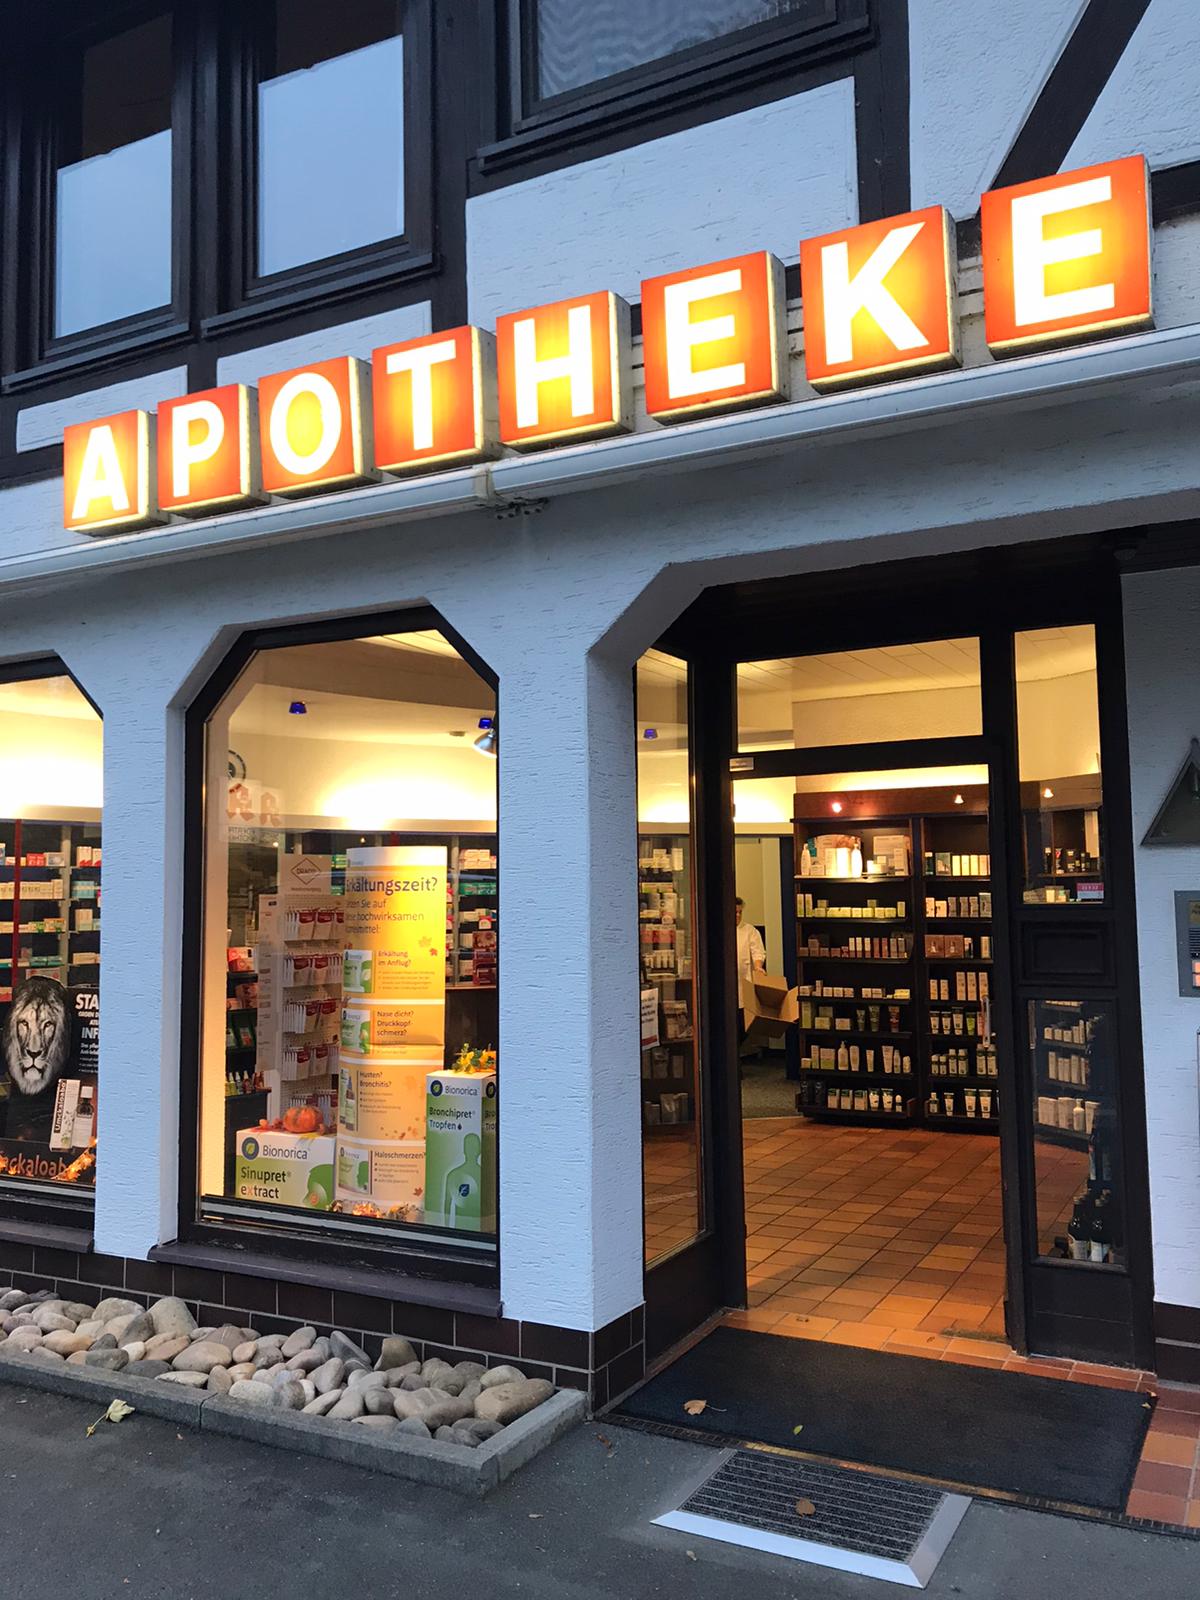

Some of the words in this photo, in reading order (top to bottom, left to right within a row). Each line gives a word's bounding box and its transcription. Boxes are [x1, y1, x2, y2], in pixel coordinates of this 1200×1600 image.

[71, 176, 1115, 519] APOTHEKE
[373, 899, 387, 909] auf
[445, 1086, 478, 1096] Bionorica
[430, 1107, 472, 1119] Bronchipret
[430, 1120, 457, 1130] Tropfen
[262, 1145, 308, 1160] Bionorica
[240, 1167, 287, 1183] Sinupret
[240, 1185, 279, 1199] extract
